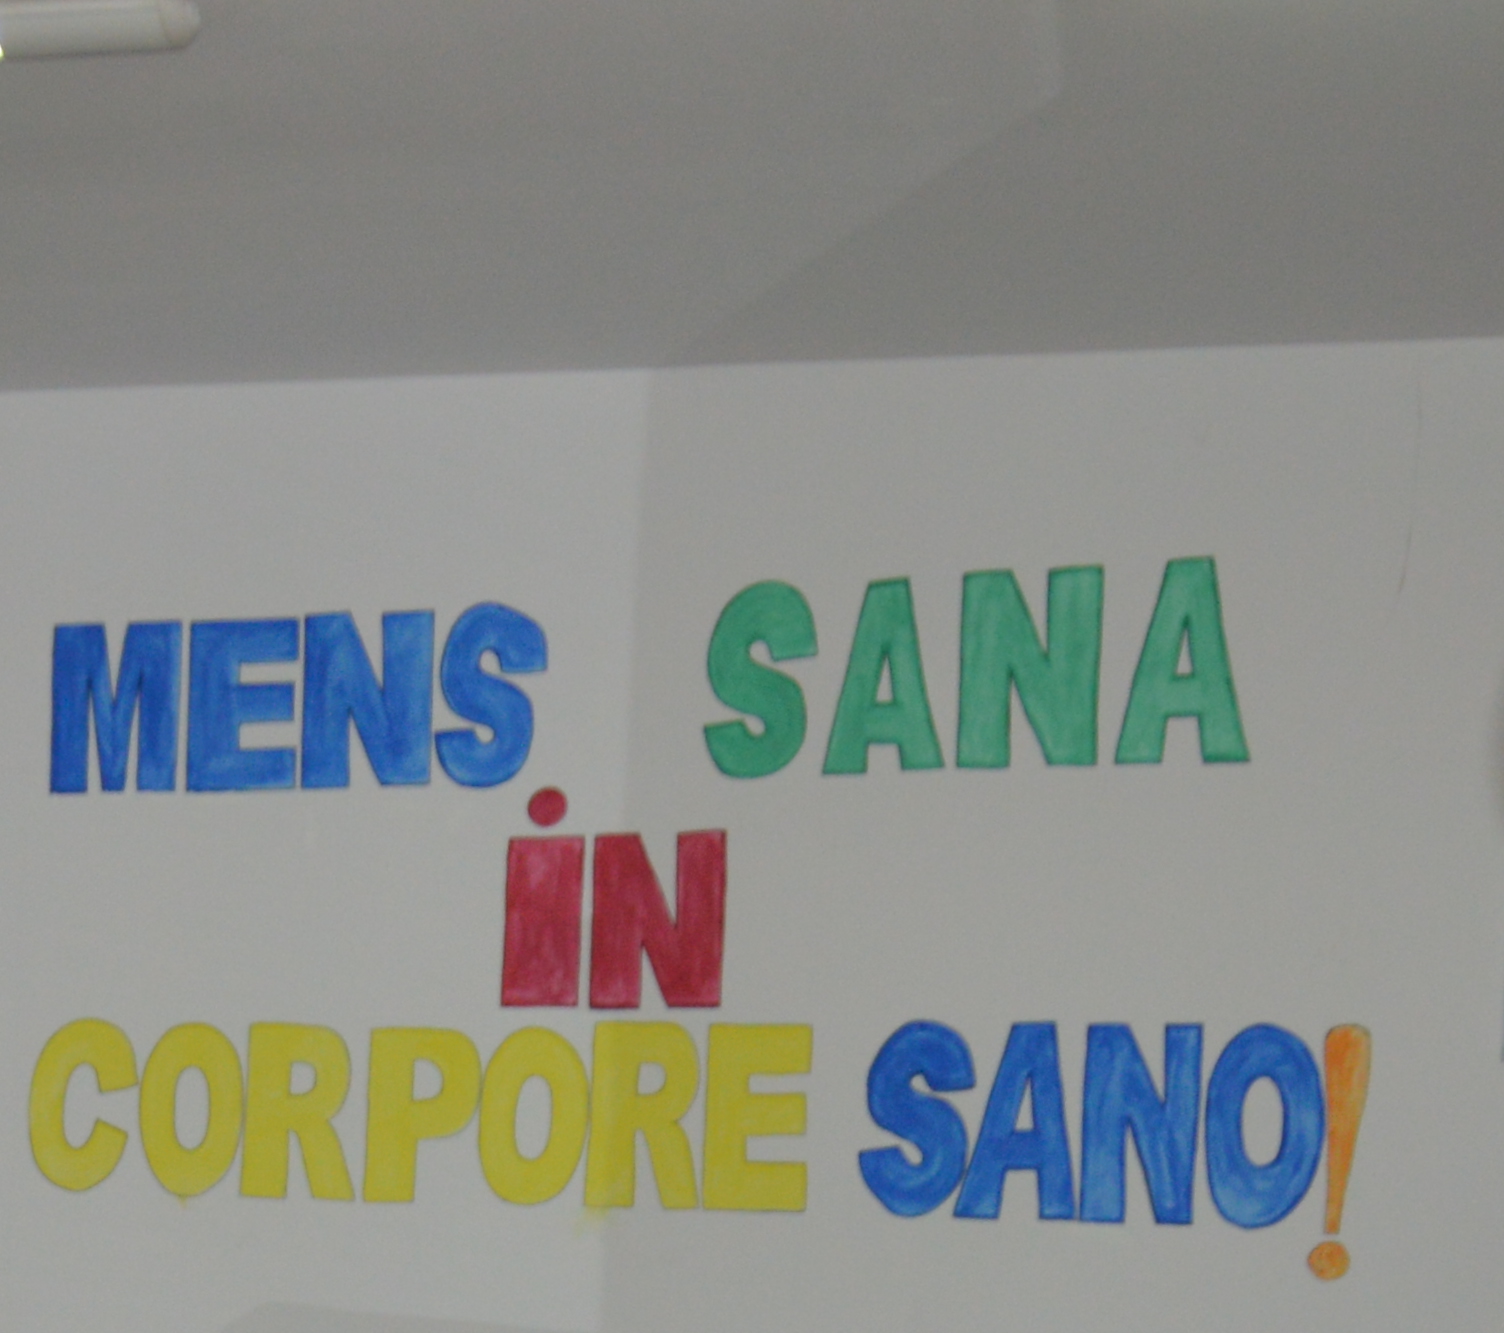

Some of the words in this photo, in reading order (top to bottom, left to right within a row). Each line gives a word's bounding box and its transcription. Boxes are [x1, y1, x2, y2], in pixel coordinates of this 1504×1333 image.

[49, 602, 548, 793] MENS
[702, 555, 1250, 780] SANA
[27, 1017, 814, 1213] CORPORE
[858, 1020, 1372, 1282] SANO!
